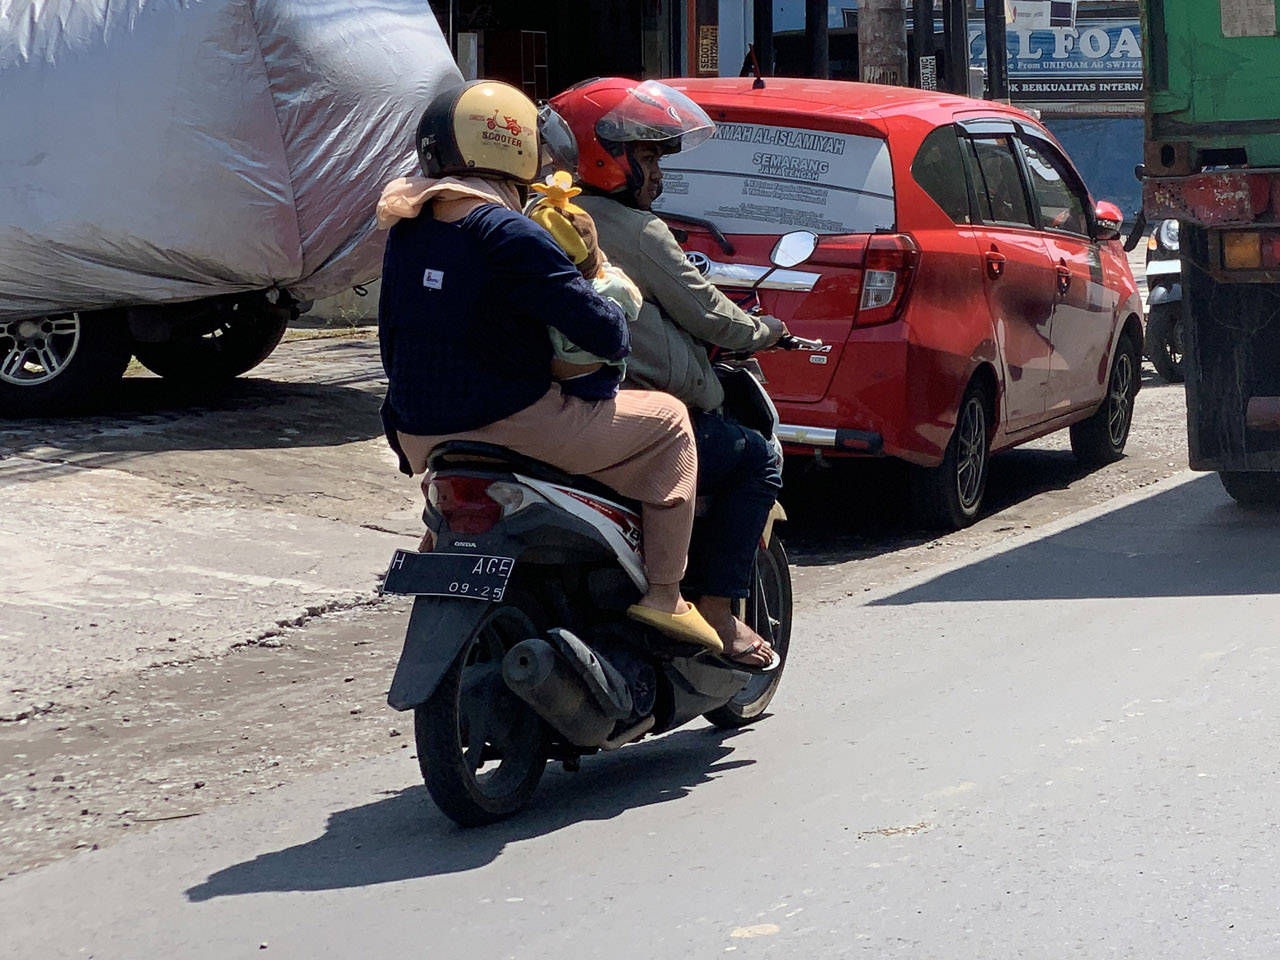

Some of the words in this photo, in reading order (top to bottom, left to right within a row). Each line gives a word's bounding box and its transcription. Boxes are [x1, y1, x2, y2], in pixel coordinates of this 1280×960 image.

[1052, 28, 1142, 59] FOA
[701, 43, 710, 69] SEDOT
[920, 58, 929, 70] WC
[1017, 61, 1041, 69] From
[1042, 60, 1088, 69] UNIFOAM
[921, 74, 930, 90] EDOT
[1022, 82, 1096, 92] BERKUALITAS
[482, 131, 522, 148] SCOOTER
[752, 128, 846, 155] AL-ISLAMIYAH
[753, 152, 830, 174] SEMARANG
[758, 166, 783, 176] JAWA
[784, 169, 819, 181] TENGAH
[392, 553, 406, 570] H
